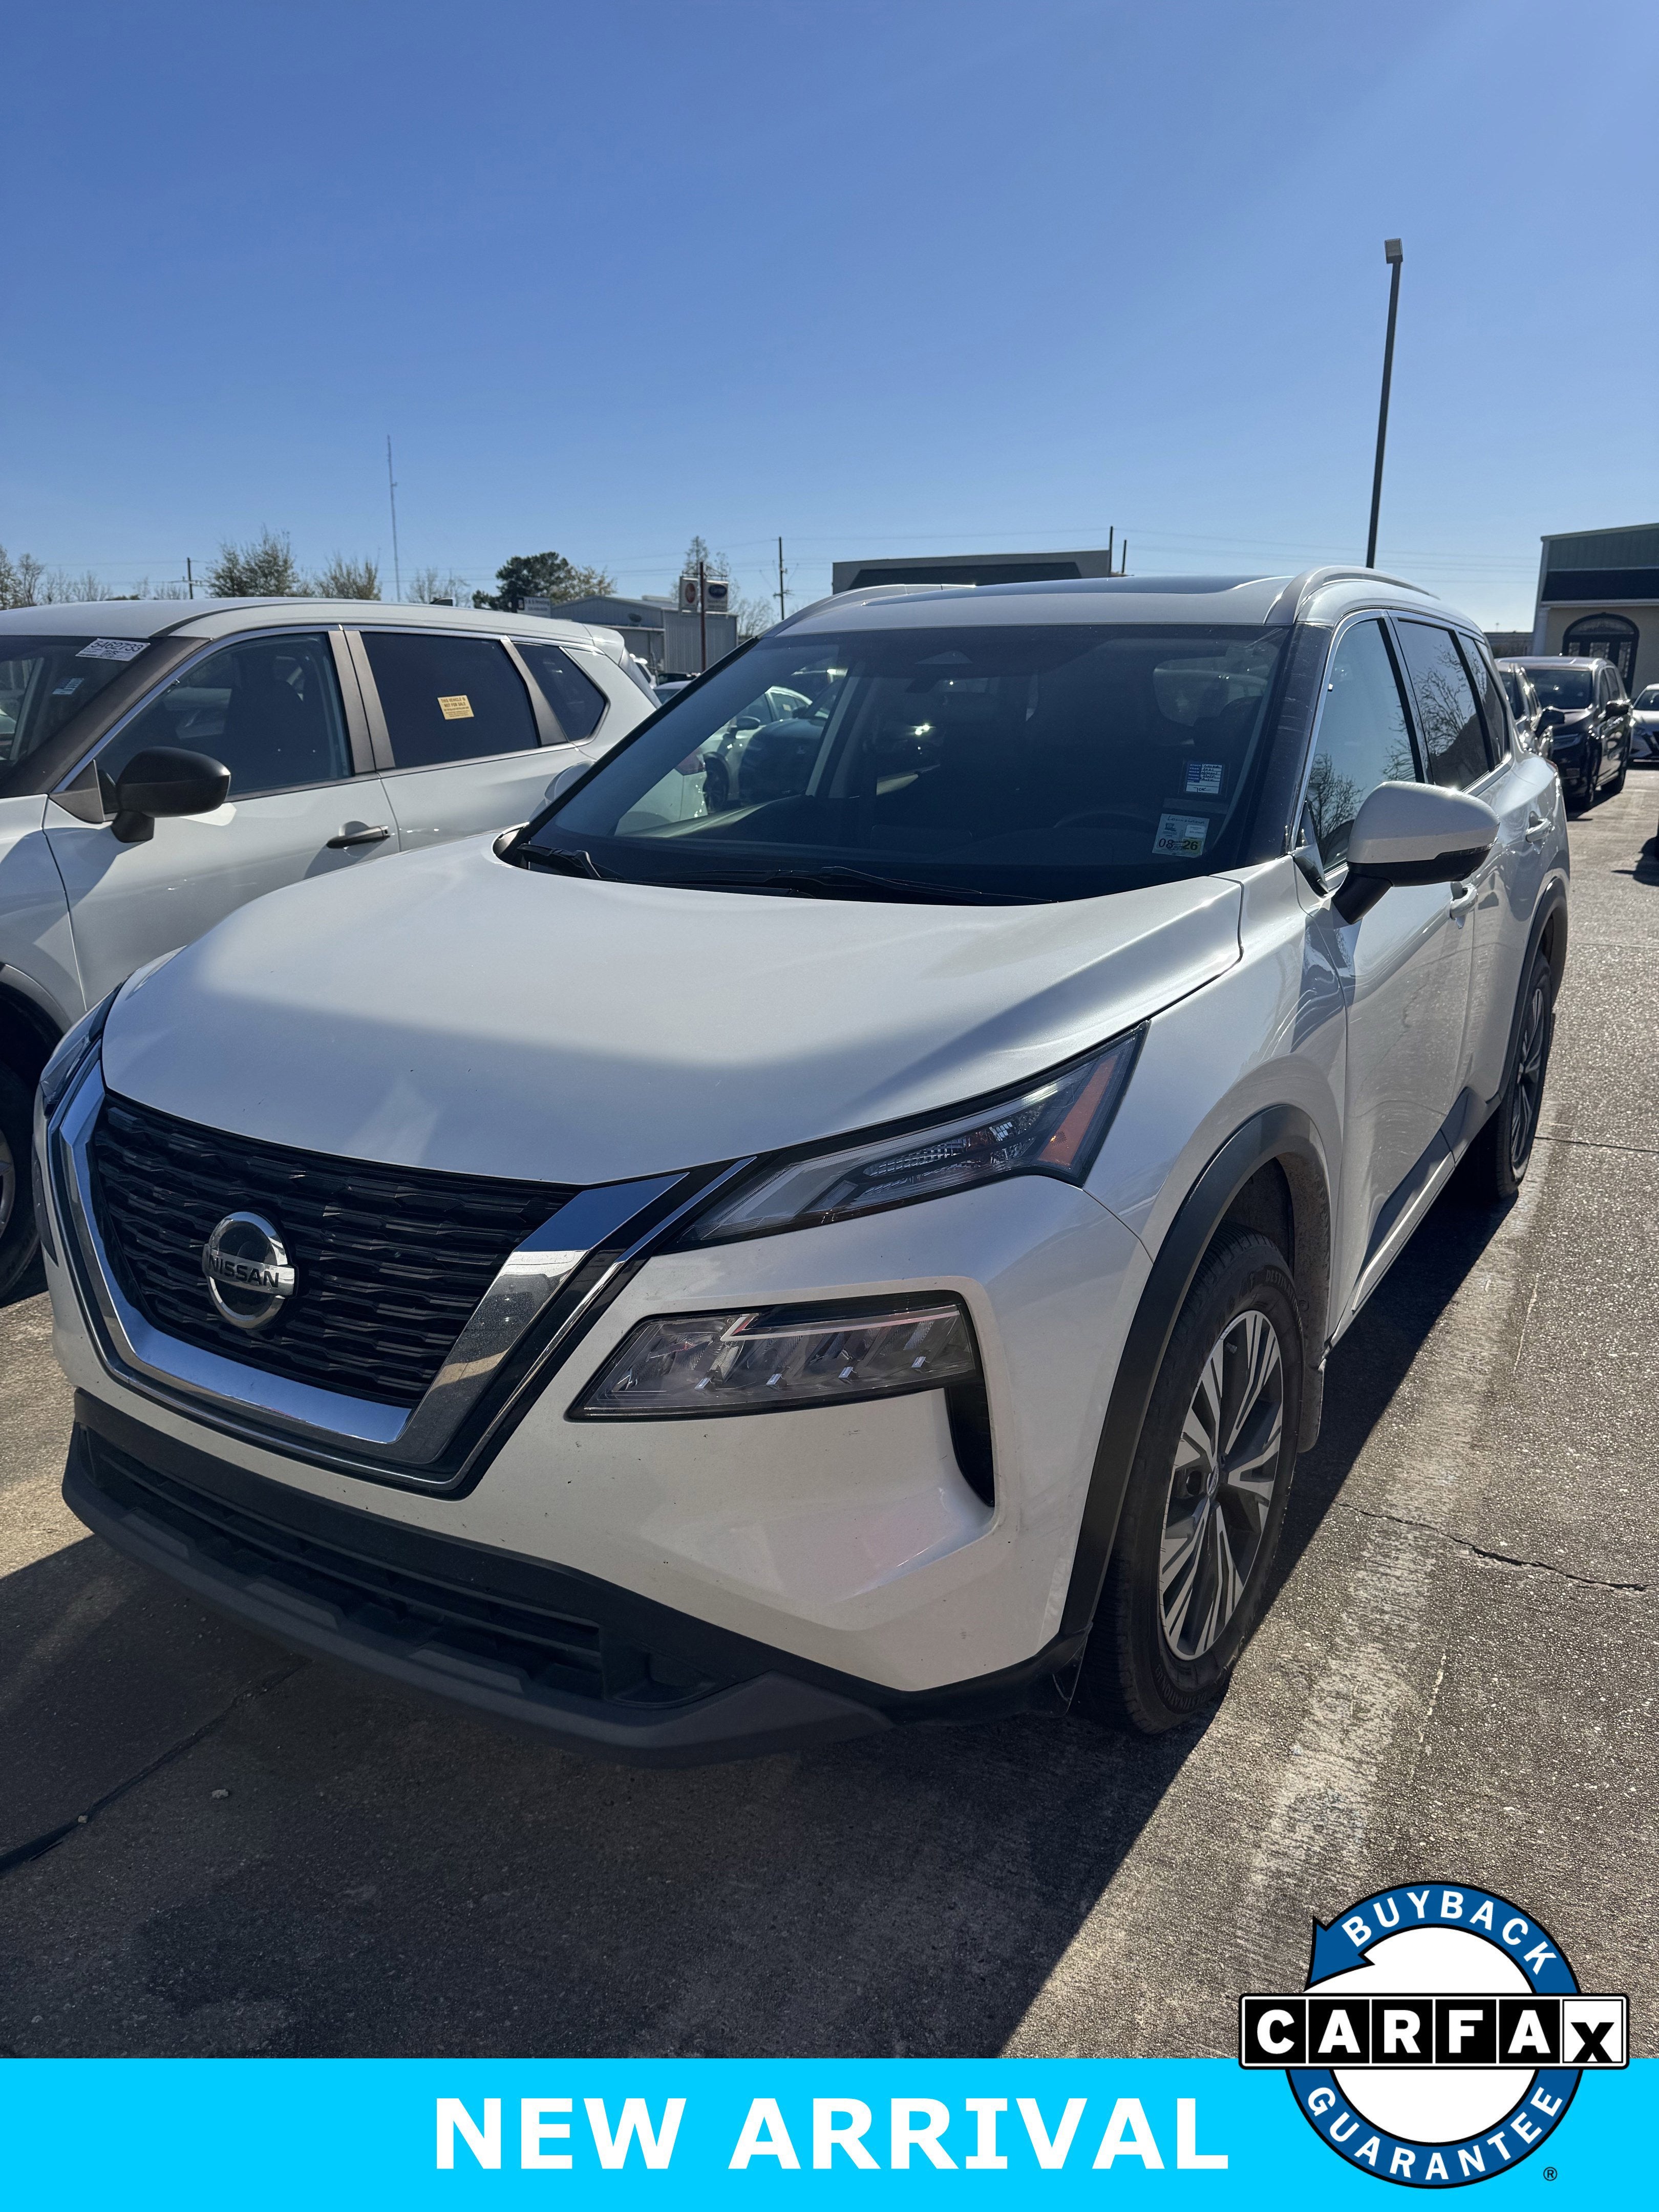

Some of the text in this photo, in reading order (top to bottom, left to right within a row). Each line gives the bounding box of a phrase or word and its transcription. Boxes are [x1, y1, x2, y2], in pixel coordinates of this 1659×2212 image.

[91, 641, 143, 652] 5462733
[1158, 838, 1174, 849] 08
[1183, 840, 1198, 850] 26
[209, 1254, 279, 1288] NISSAN
